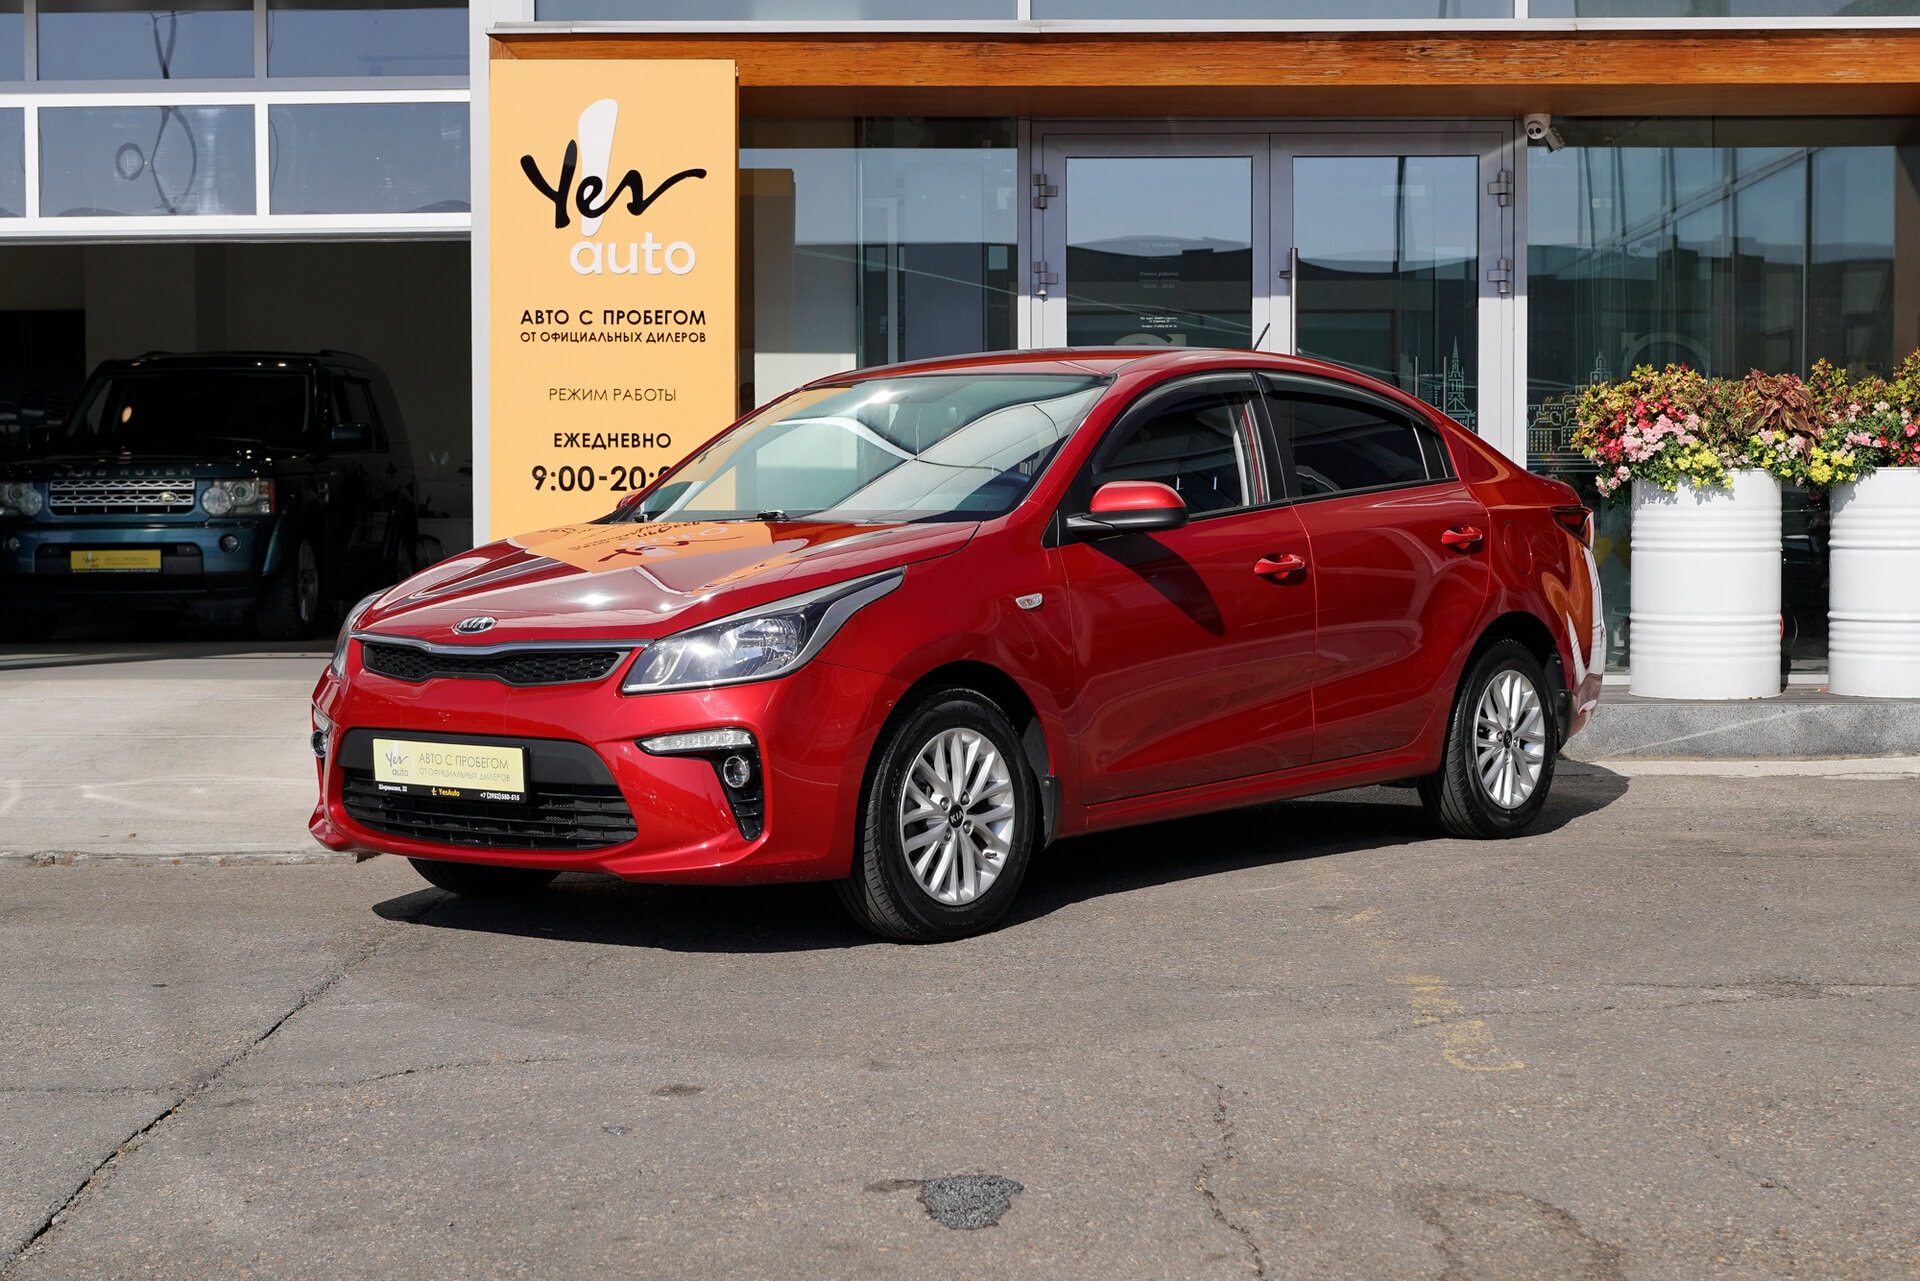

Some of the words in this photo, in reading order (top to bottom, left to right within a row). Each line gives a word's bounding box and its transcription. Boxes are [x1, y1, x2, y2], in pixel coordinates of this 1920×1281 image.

[520, 138, 707, 229] Yes
[569, 231, 698, 276] auto
[520, 310, 570, 325] АВТО
[579, 310, 594, 325] С
[603, 310, 706, 325] ПРОБЕГОМ
[520, 331, 537, 343] ОТ
[540, 331, 642, 343] ОФИЦИАЛЬНЫХ
[646, 332, 706, 344] ДИЛЕРОВ
[549, 388, 608, 401] РЕЖИМ
[613, 388, 677, 402] РАБОТЫ
[553, 432, 672, 450] ЕЖЕДНЕВНО
[53, 468, 107, 476] LAND
[119, 468, 192, 476] ROVER
[531, 465, 672, 492] 9:00-20:
[457, 616, 492, 630] KIA
[385, 750, 409, 767] Yes
[419, 753, 443, 765] АВТО
[445, 754, 453, 766] С
[455, 755, 509, 769] ПРОБЕГОМ
[392, 768, 409, 777] auto
[419, 767, 428, 776] ОТ
[428, 768, 478, 779] ОФИЦИАЛЬНЫХ
[479, 772, 511, 782] ДИЛЕРОВ
[438, 788, 460, 797] YesAuto
[950, 810, 963, 823] KIA
